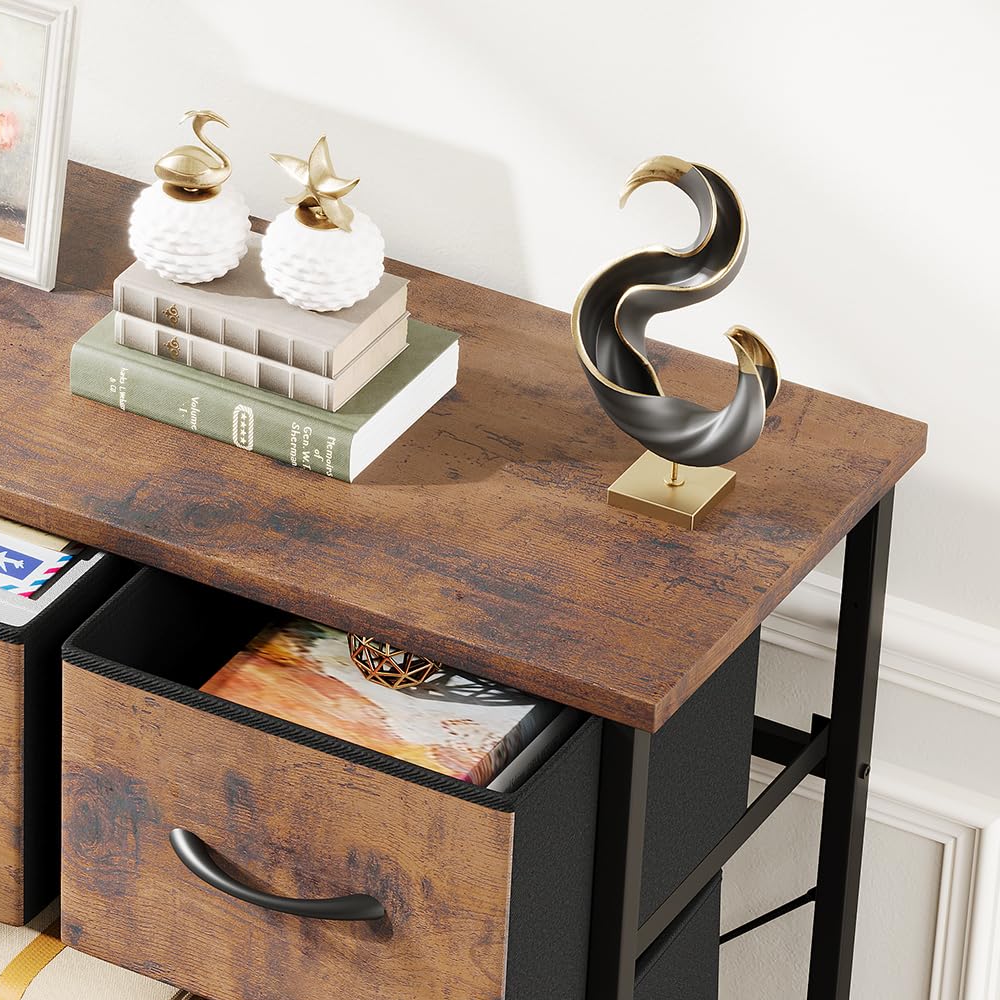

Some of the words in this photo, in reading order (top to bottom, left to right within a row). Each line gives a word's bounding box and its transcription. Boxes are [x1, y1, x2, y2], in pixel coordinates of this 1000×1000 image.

[190, 396, 201, 431] Volume
[290, 421, 301, 467] Sherman
[313, 448, 324, 462] of
[325, 436, 337, 478] Memoirs
